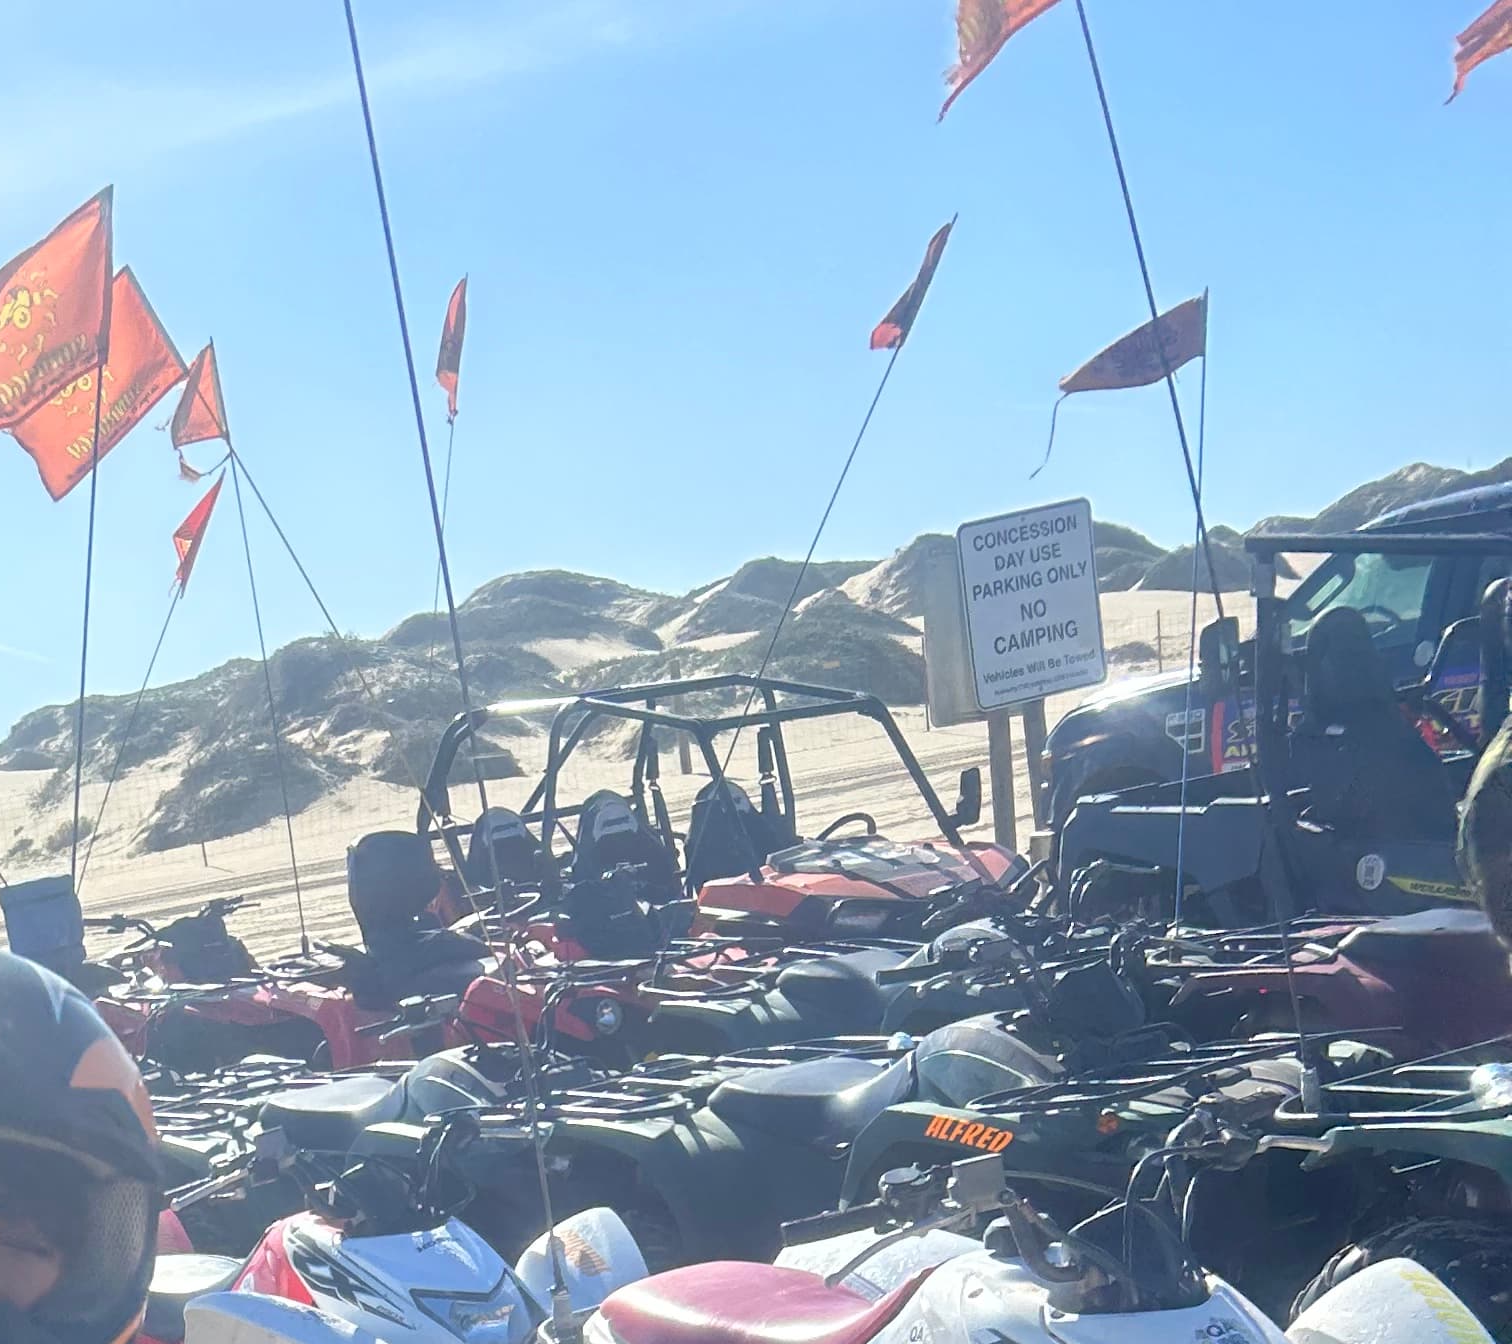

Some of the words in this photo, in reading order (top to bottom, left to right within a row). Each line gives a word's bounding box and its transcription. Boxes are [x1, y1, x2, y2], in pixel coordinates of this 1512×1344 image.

[973, 514, 1077, 552] CONCESSION
[994, 552, 1025, 571] DAY
[1030, 543, 1062, 563] USE
[972, 571, 1043, 601] PARKING
[1047, 561, 1088, 585] ONLY
[1020, 599, 1047, 621] NO
[993, 620, 1079, 655] CAMPING
[983, 667, 1025, 684] Vehicles
[1027, 660, 1046, 674] Will
[1048, 657, 1062, 669] Be
[1063, 648, 1096, 665] Towed
[924, 1114, 1014, 1153] ALFRED
